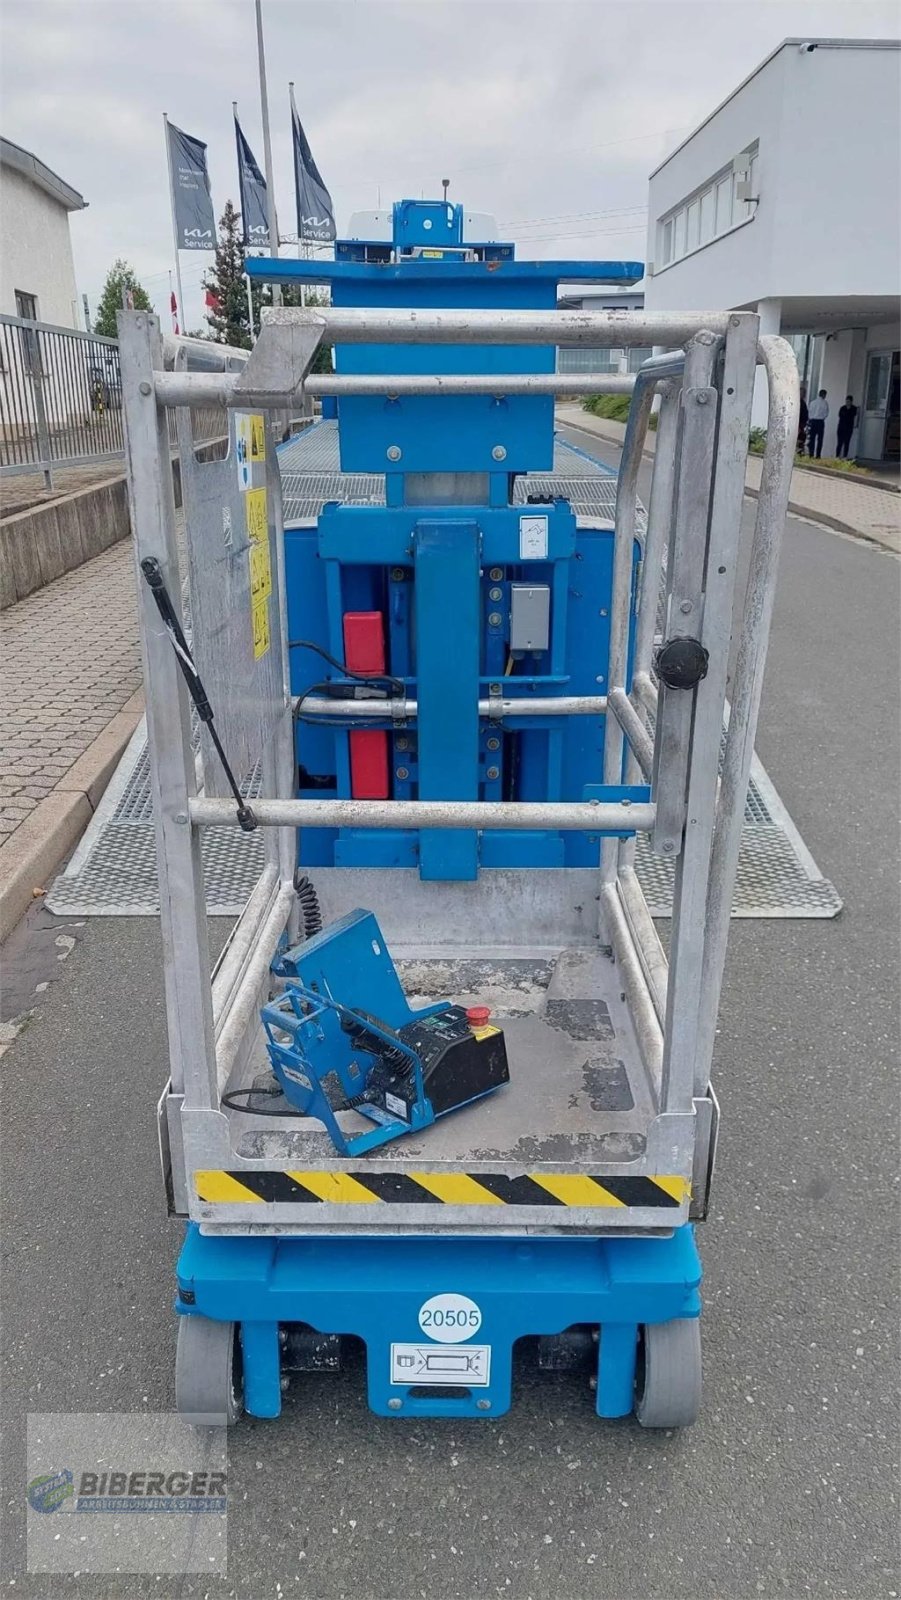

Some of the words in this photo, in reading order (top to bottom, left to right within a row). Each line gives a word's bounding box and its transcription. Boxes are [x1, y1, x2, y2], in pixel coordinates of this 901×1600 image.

[303, 227, 331, 239] Service
[184, 239, 213, 249] Service
[421, 1310, 479, 1327] 20505
